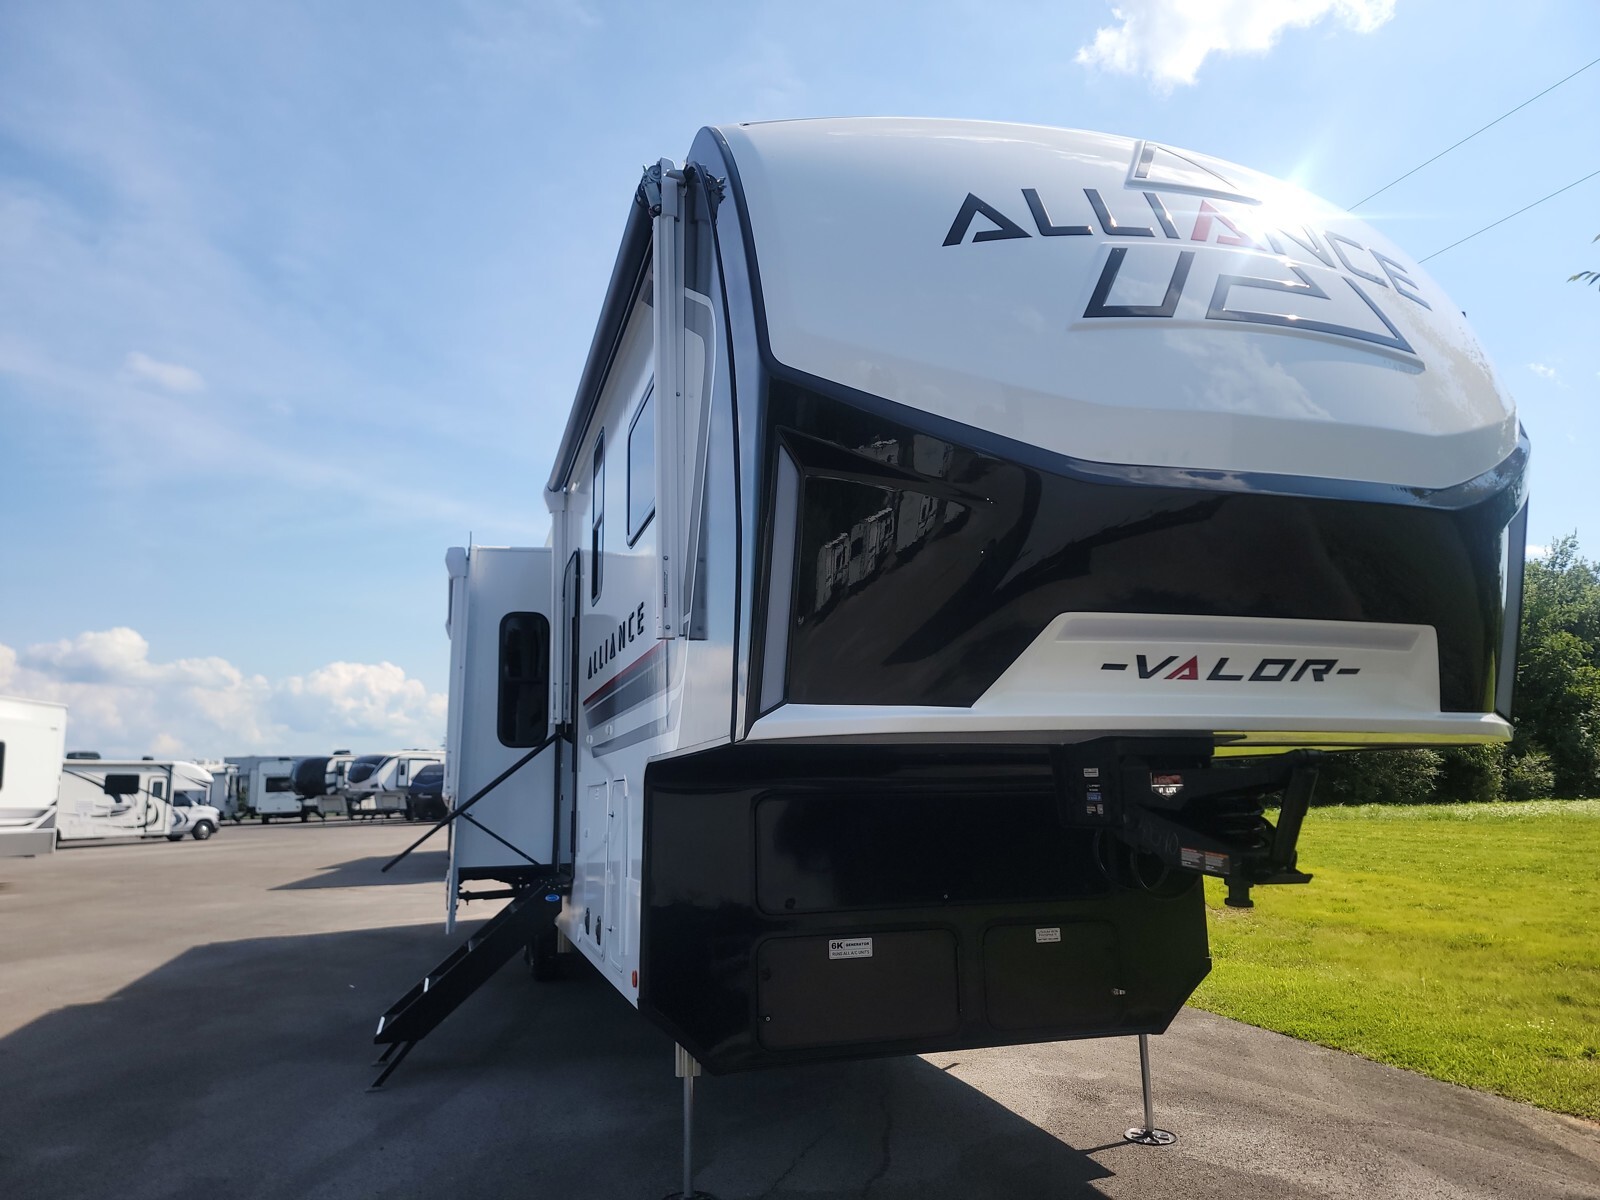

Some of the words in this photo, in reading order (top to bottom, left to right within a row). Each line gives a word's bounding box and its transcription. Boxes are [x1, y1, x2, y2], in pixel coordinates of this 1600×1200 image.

[942, 188, 1432, 311] ALLIANCE
[587, 601, 645, 680] ALLIANCE
[831, 942, 844, 950] 6K
